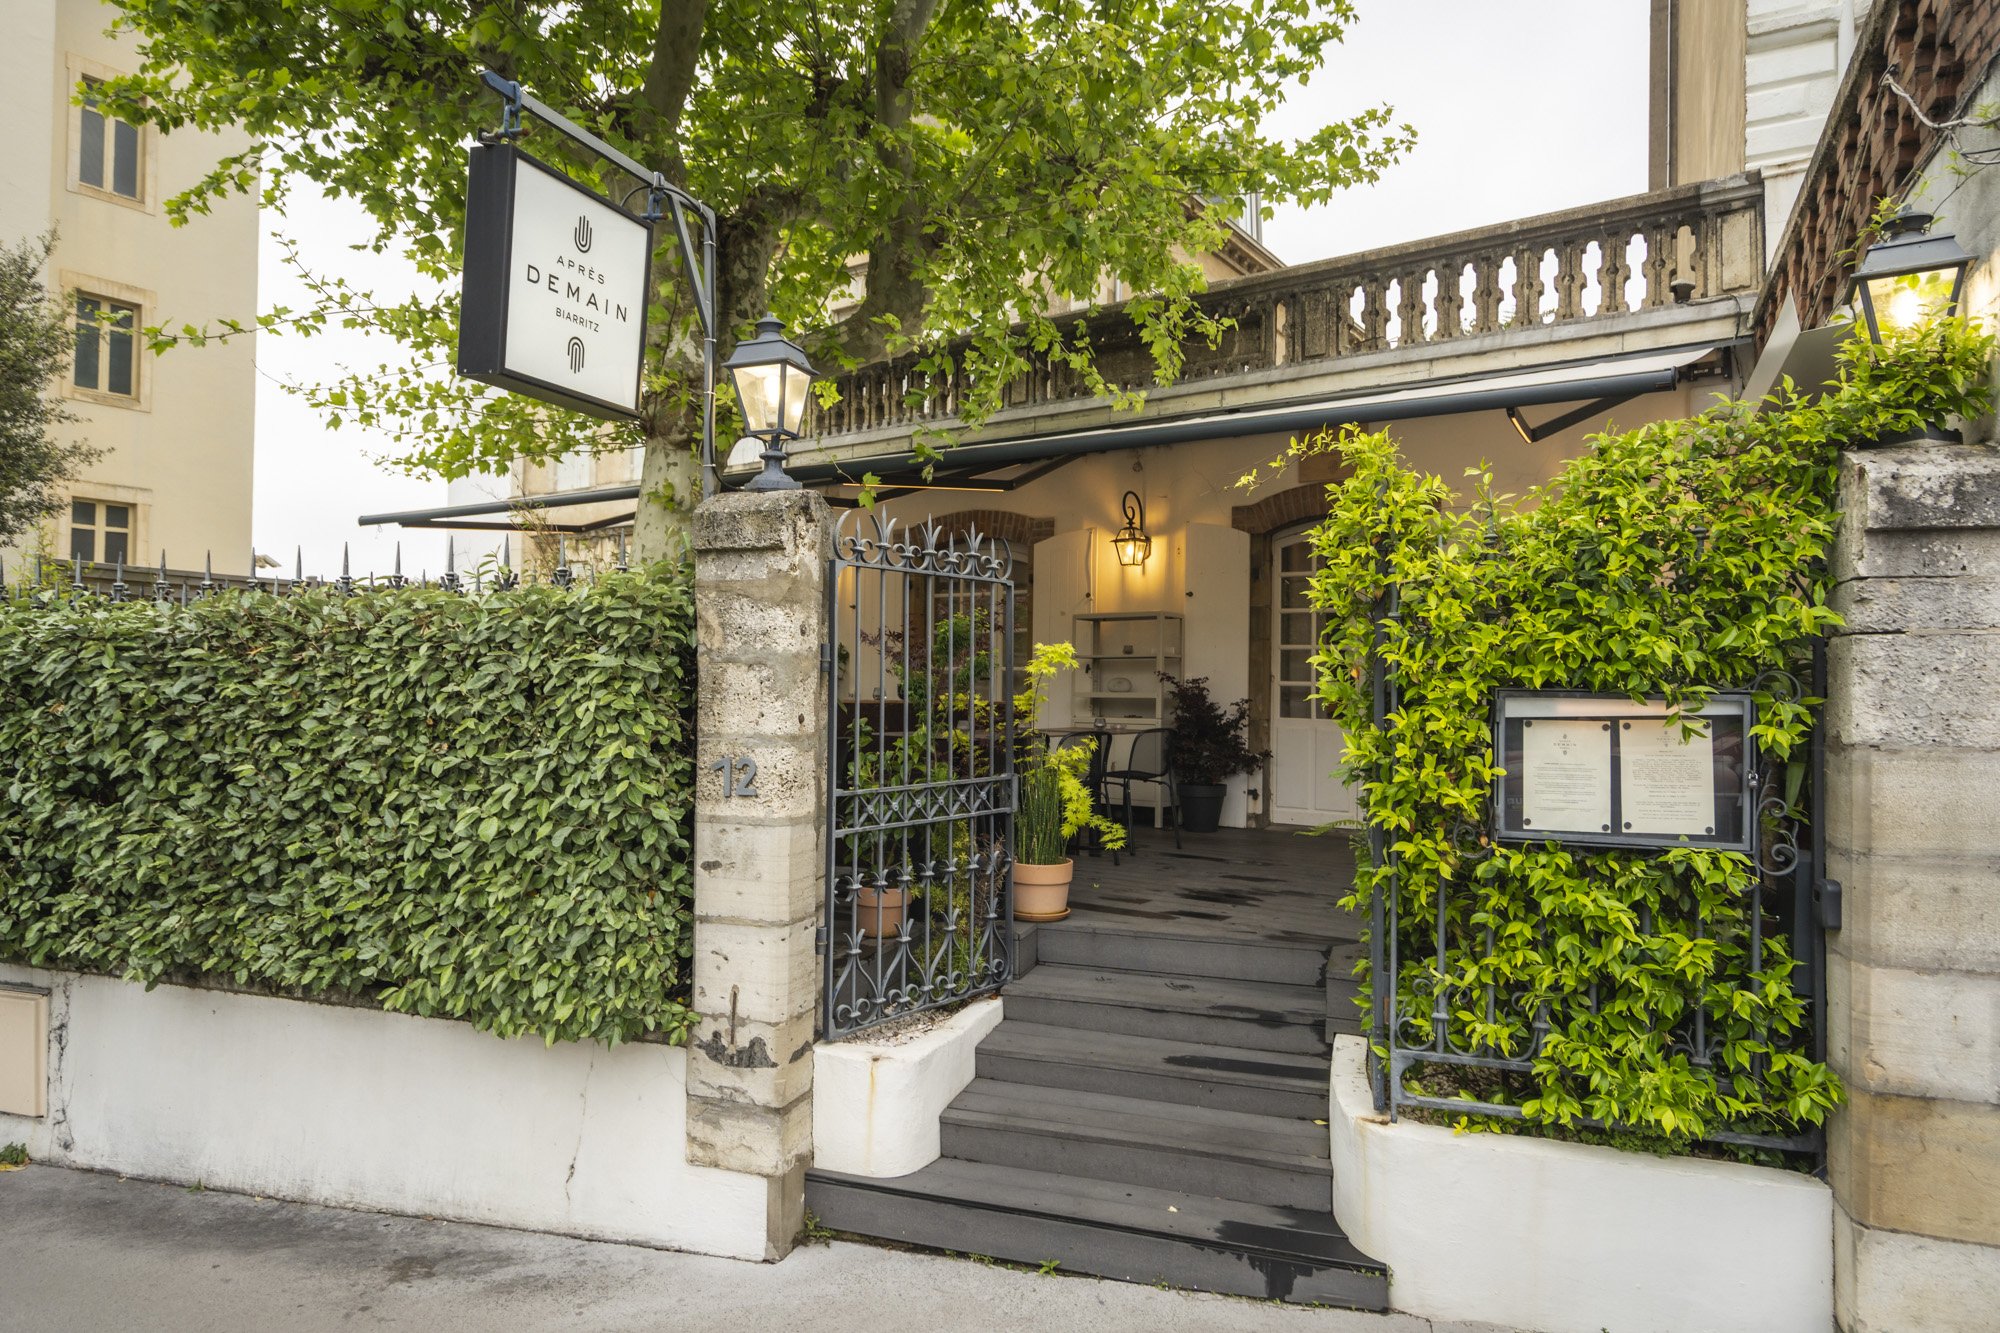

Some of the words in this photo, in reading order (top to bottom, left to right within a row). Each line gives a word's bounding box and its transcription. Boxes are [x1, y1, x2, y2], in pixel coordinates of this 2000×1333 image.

[556, 255, 605, 285] APRÈS
[526, 263, 627, 323] DEMAIN
[555, 306, 600, 333] BIARRITZ
[711, 757, 757, 798] 12
